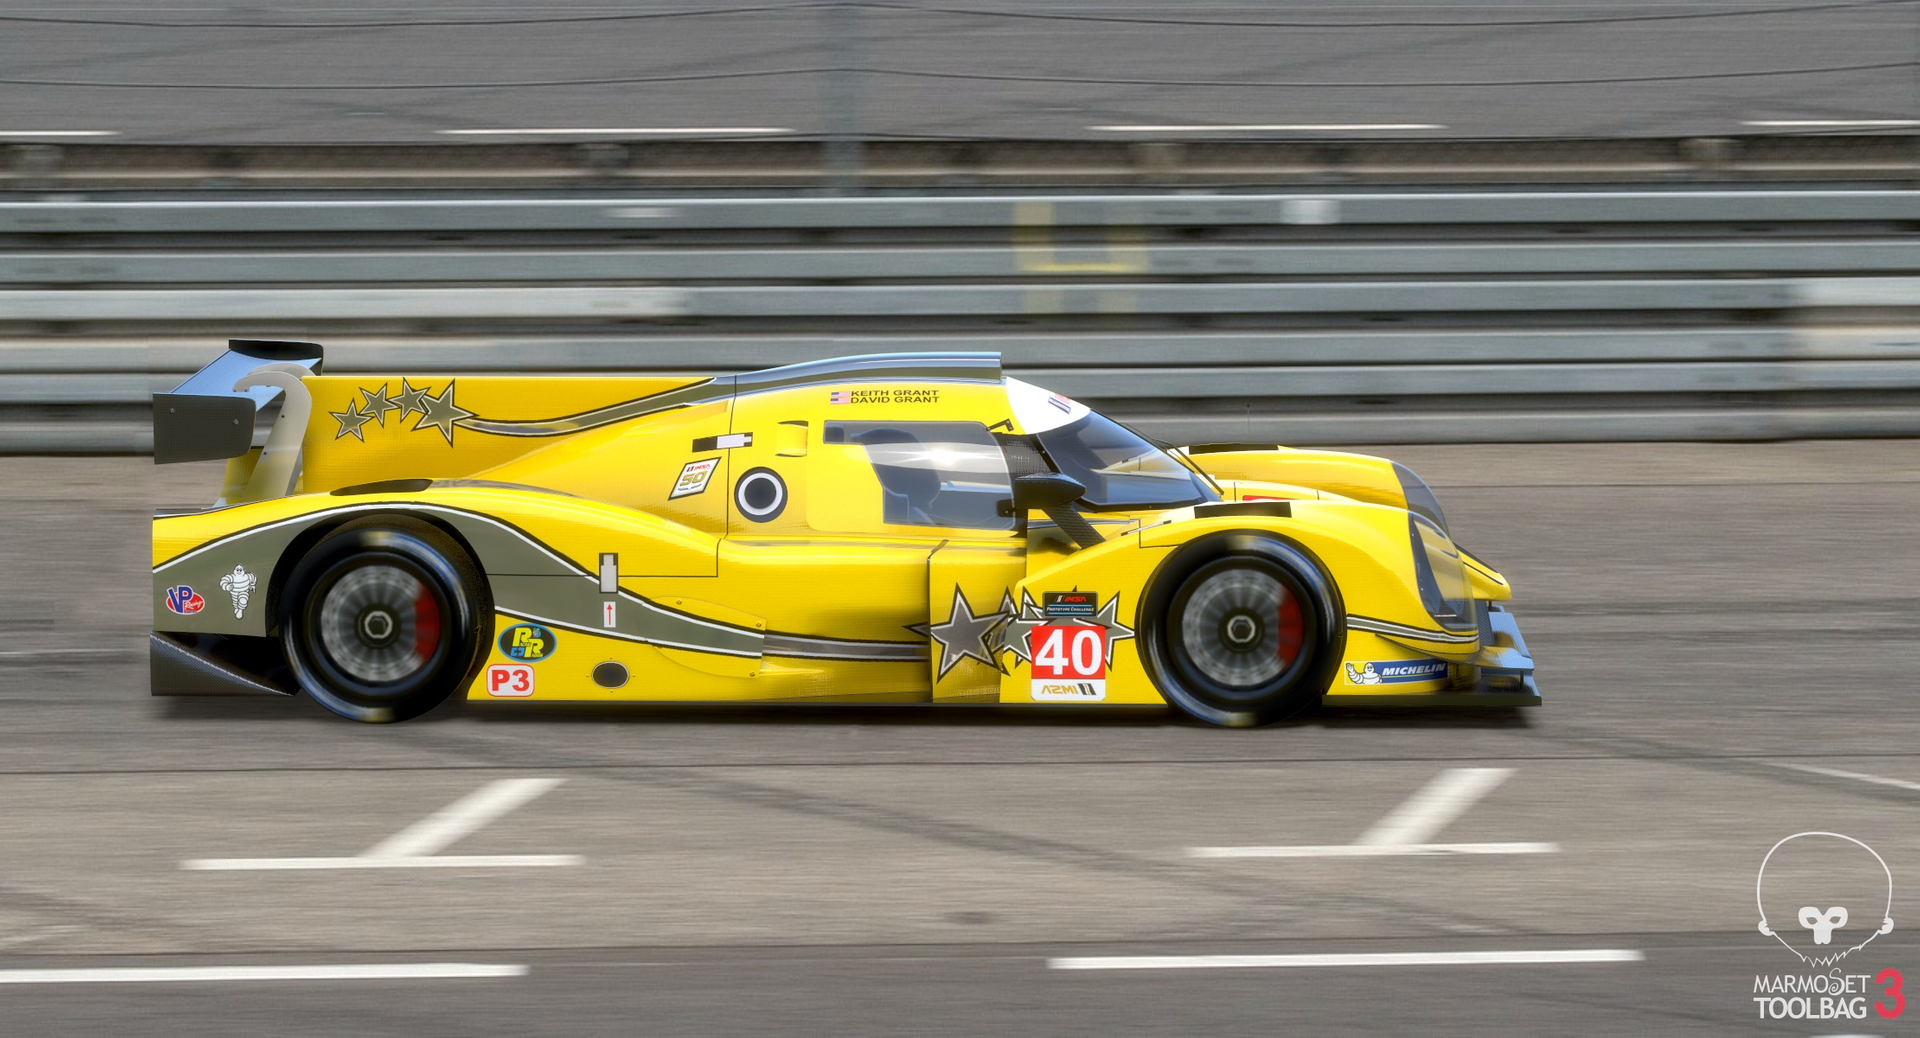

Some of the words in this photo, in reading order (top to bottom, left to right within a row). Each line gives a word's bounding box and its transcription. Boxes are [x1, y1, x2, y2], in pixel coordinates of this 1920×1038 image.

[850, 396, 891, 404] DAVID
[679, 470, 708, 487] 50
[166, 585, 194, 614] VP
[1035, 628, 1103, 676] 40
[1382, 662, 1446, 676] MICHELIN
[492, 669, 530, 692] P3
